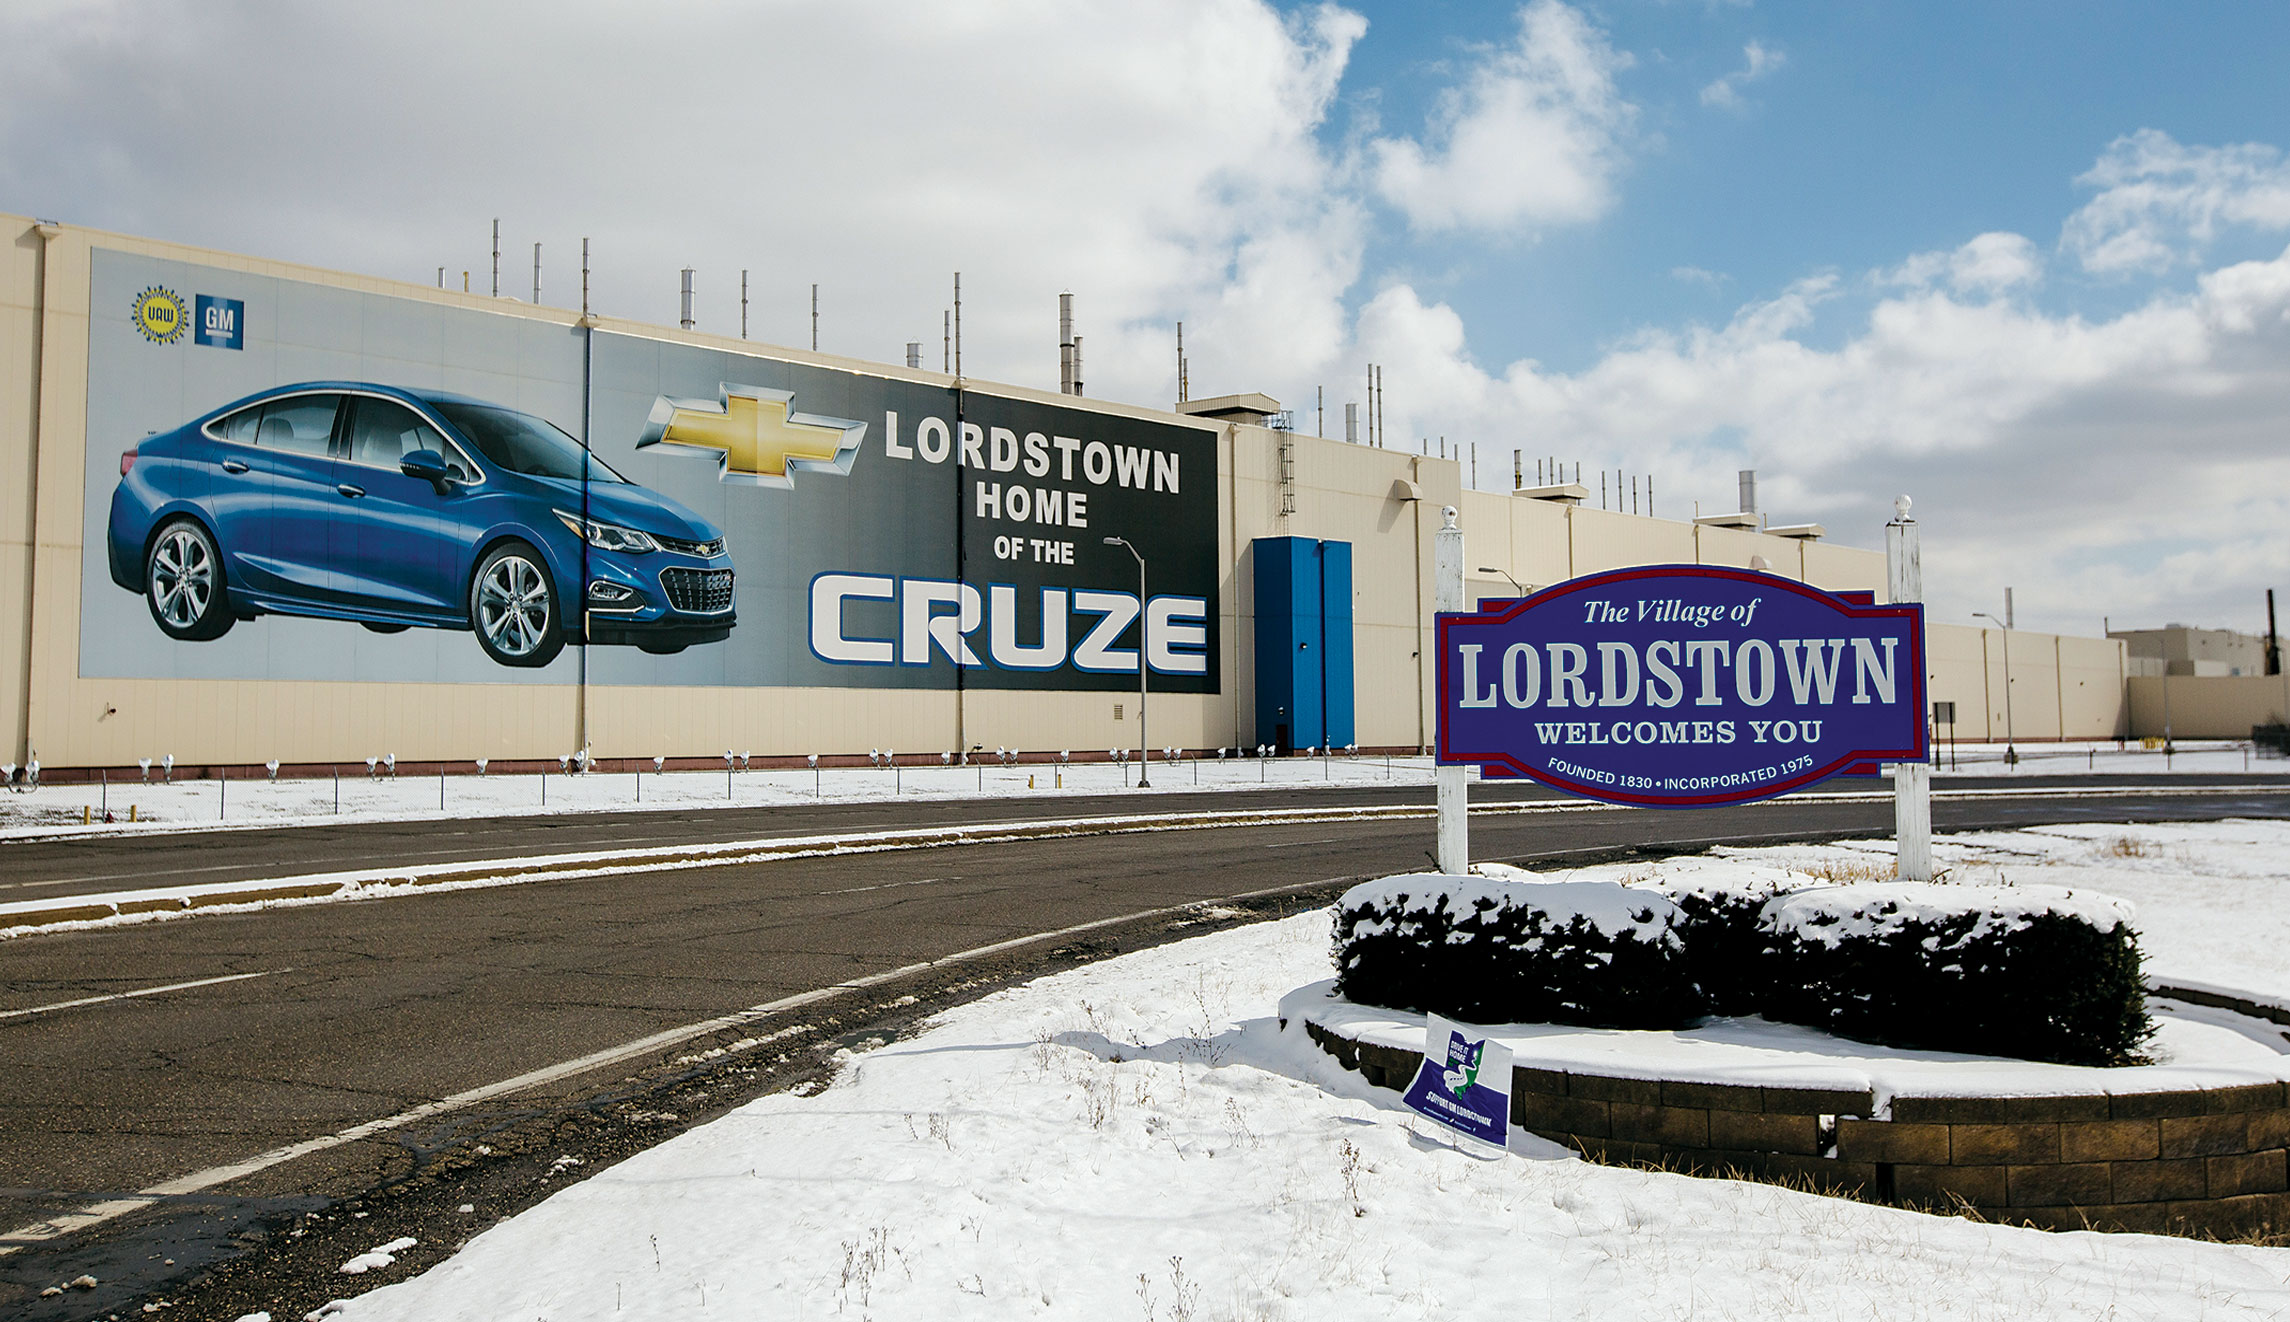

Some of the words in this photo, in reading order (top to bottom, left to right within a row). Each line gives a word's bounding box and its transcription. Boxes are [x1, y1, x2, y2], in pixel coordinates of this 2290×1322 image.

[148, 306, 174, 323] UAW
[205, 306, 234, 331] GM
[885, 410, 1180, 494] LORDSTOWN
[976, 480, 1088, 528] HOME
[994, 535, 1024, 561] OF
[1029, 539, 1075, 565] THE
[808, 570, 1207, 676] CRUZE
[1584, 599, 1629, 624] The
[1637, 599, 1726, 628] Village
[1731, 597, 1761, 628] of
[1458, 637, 1898, 709] LORDSTOWN
[1534, 720, 1735, 746] WELCOMES
[1748, 719, 1823, 744] YOU
[1548, 756, 1616, 786] FOUNDED
[1620, 774, 1653, 789] 1830
[1664, 766, 1777, 790] INCORPORATED
[1781, 754, 1814, 776] 1975
